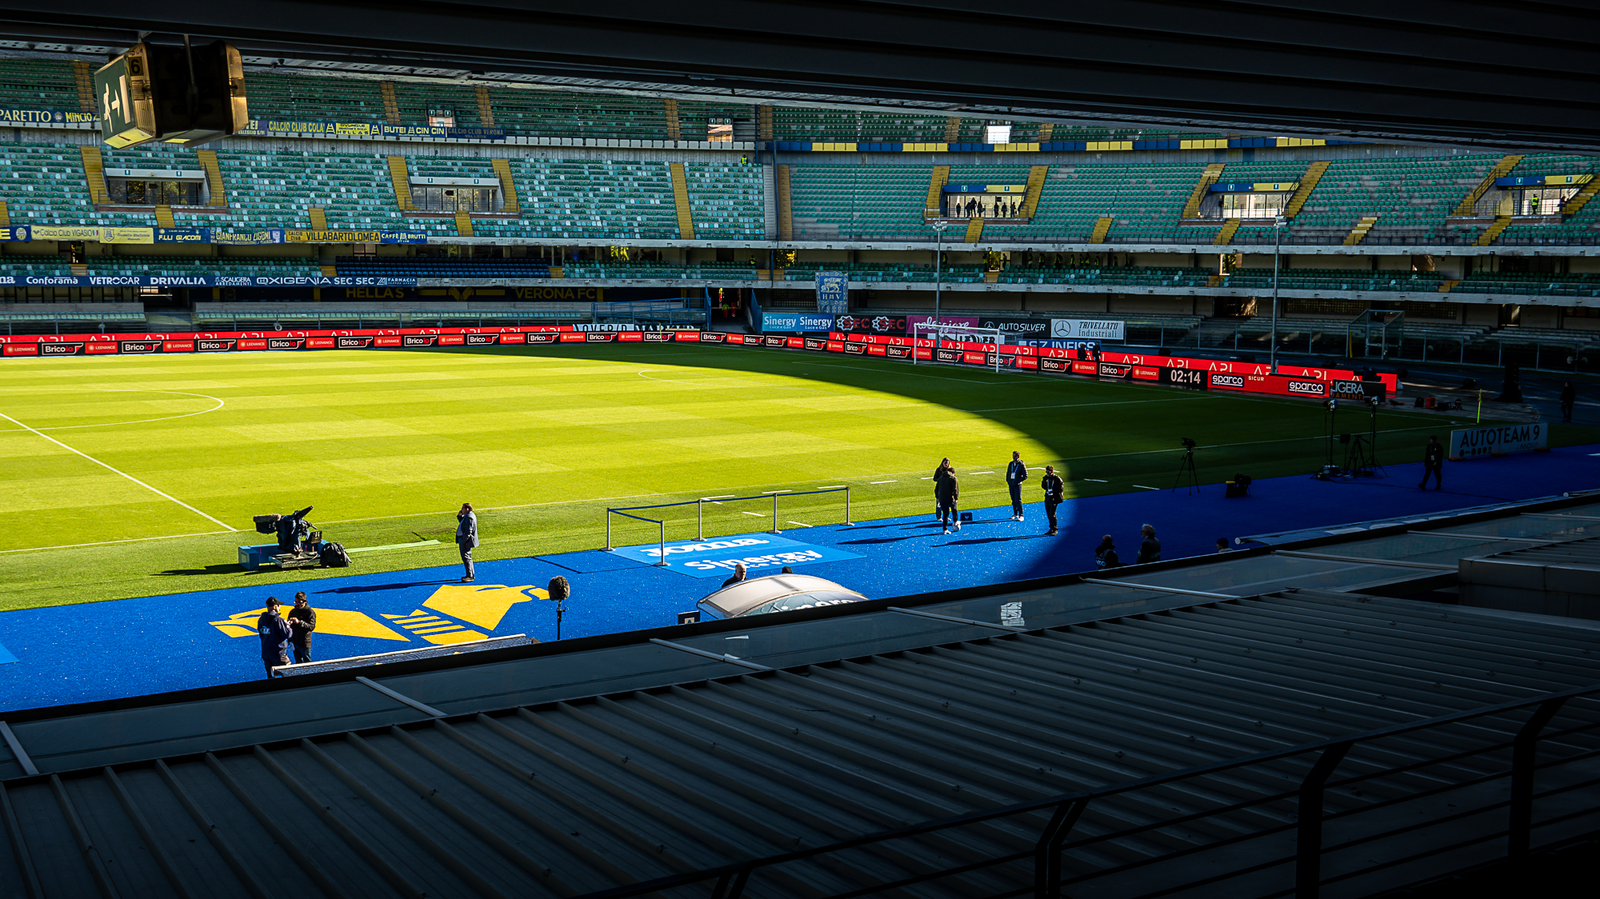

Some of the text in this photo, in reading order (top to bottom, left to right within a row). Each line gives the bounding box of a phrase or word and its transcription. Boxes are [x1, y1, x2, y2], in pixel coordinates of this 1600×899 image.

[130, 58, 140, 74] 6
[268, 121, 290, 132] CALCIO
[292, 122, 308, 132] CLUB
[40, 228, 57, 236] Calcio
[306, 232, 380, 241] VILLABARTOLOMEA
[90, 276, 140, 284] VETROCAR
[514, 288, 574, 299] VERONA
[578, 288, 596, 298] FC
[764, 316, 832, 328] Sinergy Sinergy
[844, 318, 905, 329] SEC SEC
[998, 322, 1046, 332] AUTOSILVER
[1079, 322, 1118, 330] TRIVELLATO
[1079, 330, 1117, 338] Industriali
[1170, 370, 1201, 384] 02:14
[1212, 374, 1244, 385] sparco
[1289, 381, 1324, 393] sparco
[1460, 424, 1540, 448] AUTOTEAM 9
[684, 550, 823, 570] Sinergy
